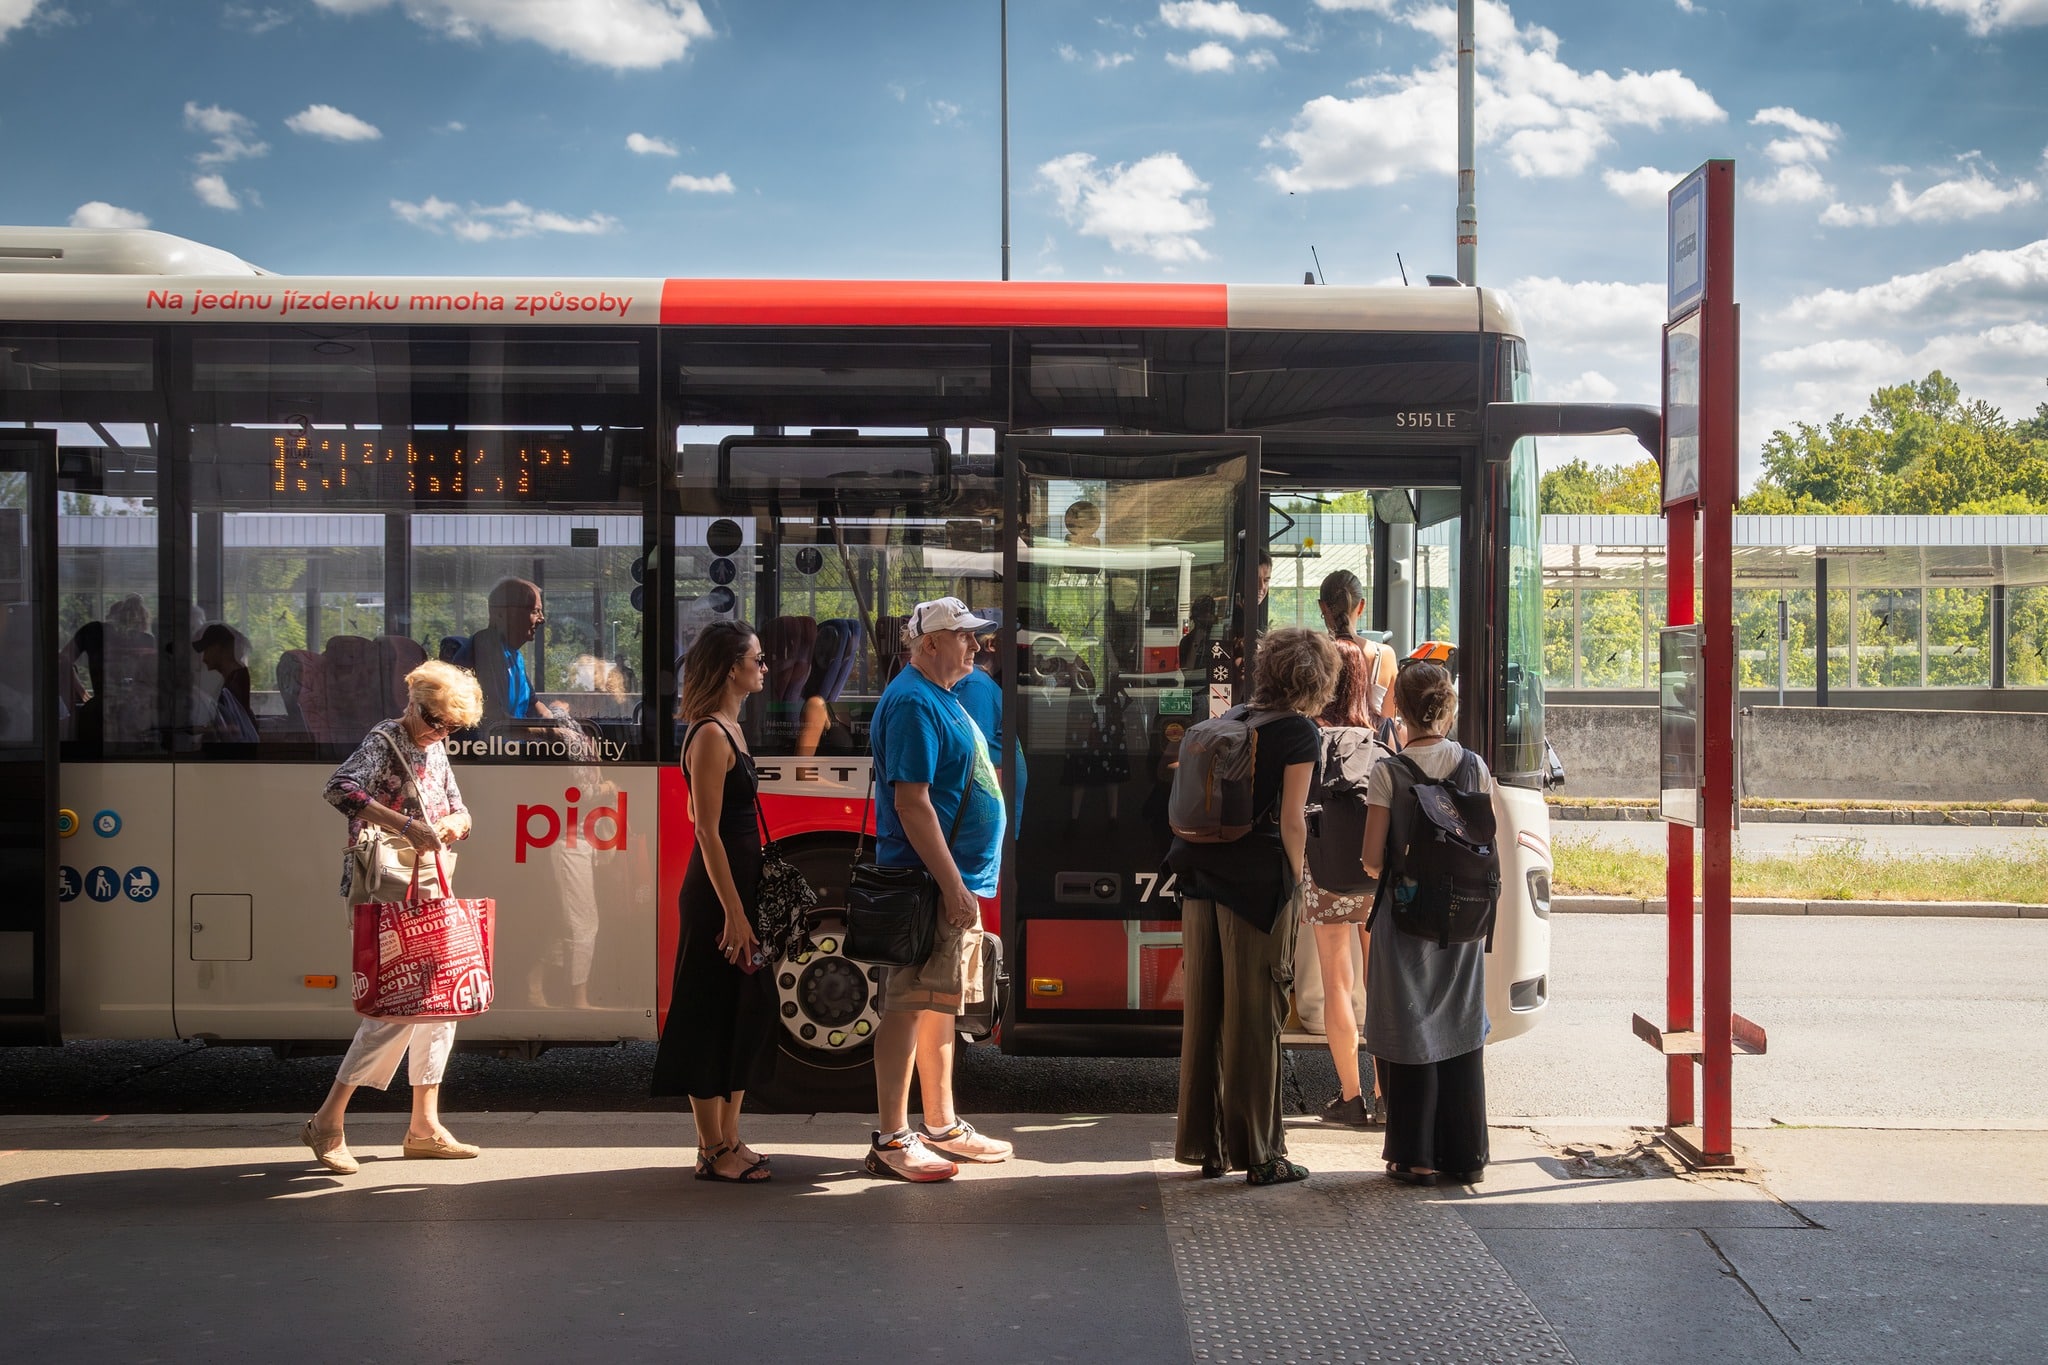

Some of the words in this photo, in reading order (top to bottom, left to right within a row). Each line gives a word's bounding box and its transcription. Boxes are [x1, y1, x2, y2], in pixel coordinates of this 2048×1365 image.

[146, 290, 183, 309] Na
[191, 289, 272, 315] jednu
[280, 289, 399, 316] jízdenku
[409, 291, 504, 311] mnoha
[514, 291, 633, 317] způsoby
[1396, 412, 1406, 427] S
[1408, 412, 1432, 427] 515
[1436, 412, 1456, 428] LE
[526, 736, 627, 761] mobility
[515, 786, 628, 864] pid
[404, 913, 457, 938] money
[379, 961, 419, 982] eathe
[380, 972, 422, 995] eeply
